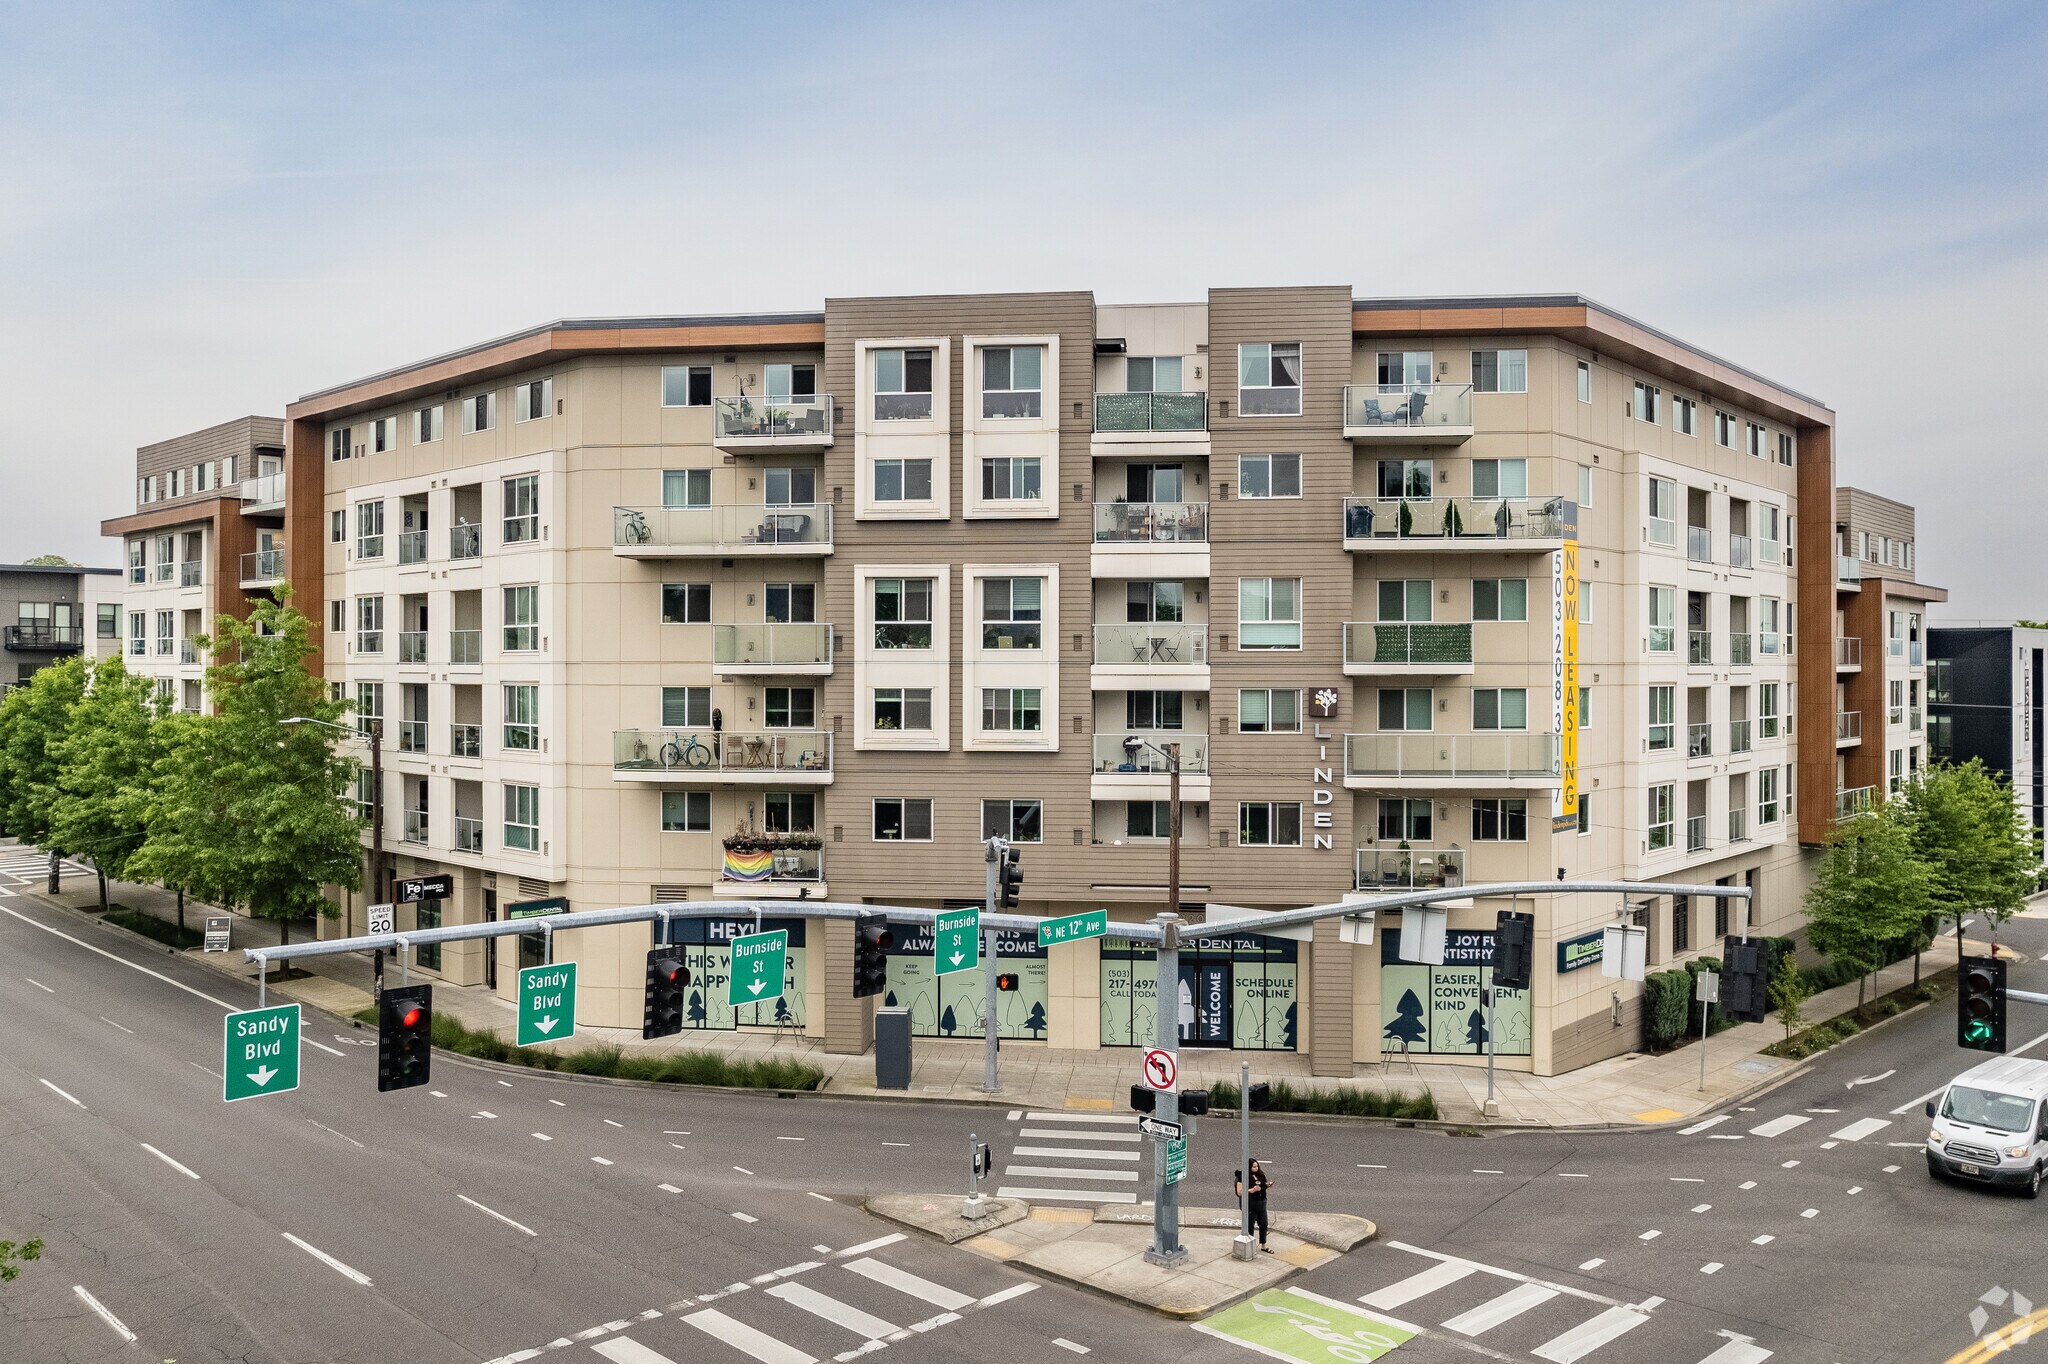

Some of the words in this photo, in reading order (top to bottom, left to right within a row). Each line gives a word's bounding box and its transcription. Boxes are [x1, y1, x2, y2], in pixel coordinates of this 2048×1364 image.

[1565, 550, 1576, 621] NOW
[1566, 636, 1574, 805] LEASING
[1314, 723, 1333, 849] LINDEN
[406, 884, 421, 894] Fe
[424, 883, 444, 891] MECCA
[370, 906, 391, 914] SPEED
[371, 919, 391, 933] 20
[939, 915, 976, 931] Burnside
[1055, 926, 1066, 938] NE
[1086, 921, 1100, 932] Ave
[953, 935, 961, 946] St
[736, 939, 782, 957] Burnside
[686, 955, 716, 968] HIS
[752, 960, 763, 973] St
[527, 971, 568, 990] Sandy
[1235, 978, 1294, 988] SCHEDULE
[1434, 974, 1480, 987] EASIER,
[1247, 989, 1290, 999] ONLINE
[1434, 988, 1522, 1000] CONVEENT,
[533, 992, 561, 1011] Blvd
[1210, 972, 1221, 1037] WELCOME
[1434, 1000, 1466, 1010] KIND
[237, 1015, 289, 1037] Sandy
[245, 1039, 280, 1060] Blvd
[1151, 1123, 1163, 1131] ONE
